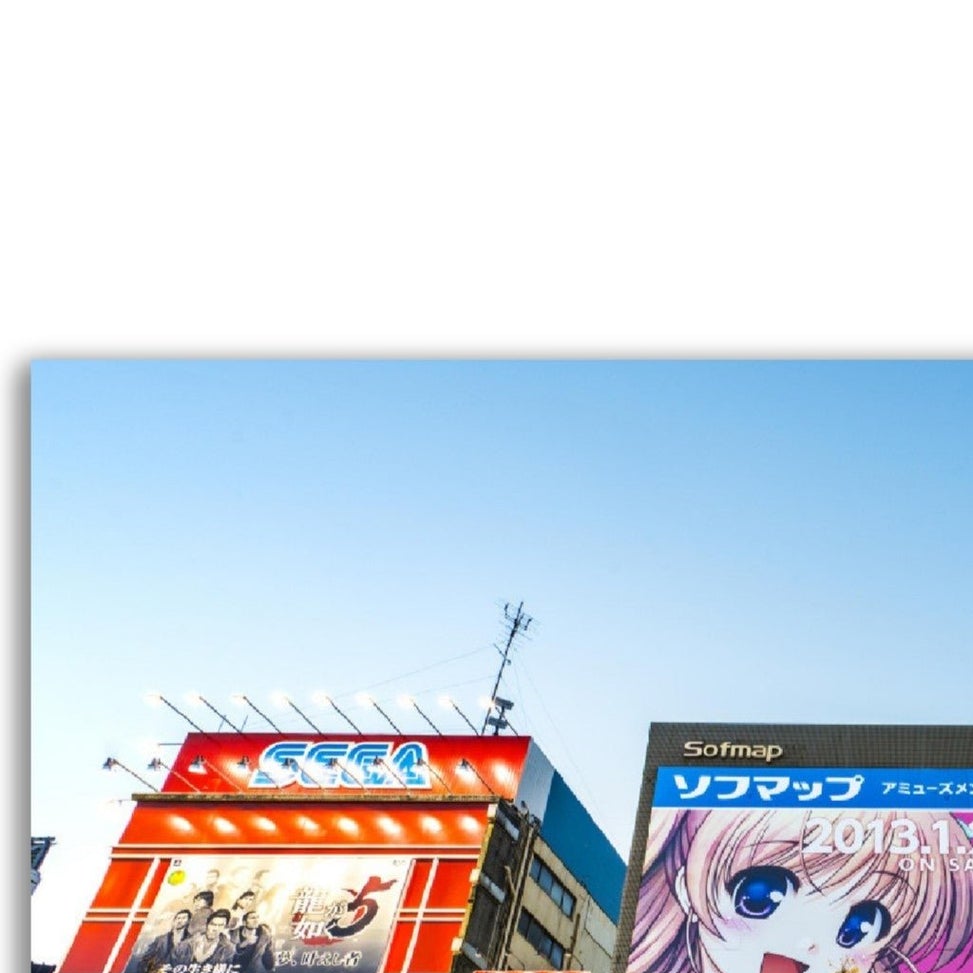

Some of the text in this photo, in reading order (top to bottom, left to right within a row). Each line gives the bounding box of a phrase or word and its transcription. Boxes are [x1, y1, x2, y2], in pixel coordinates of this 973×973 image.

[683, 741, 783, 762] Sofmap
[249, 742, 432, 788] SEGA
[673, 774, 865, 801] ソフマップ
[898, 858, 934, 873] ON
